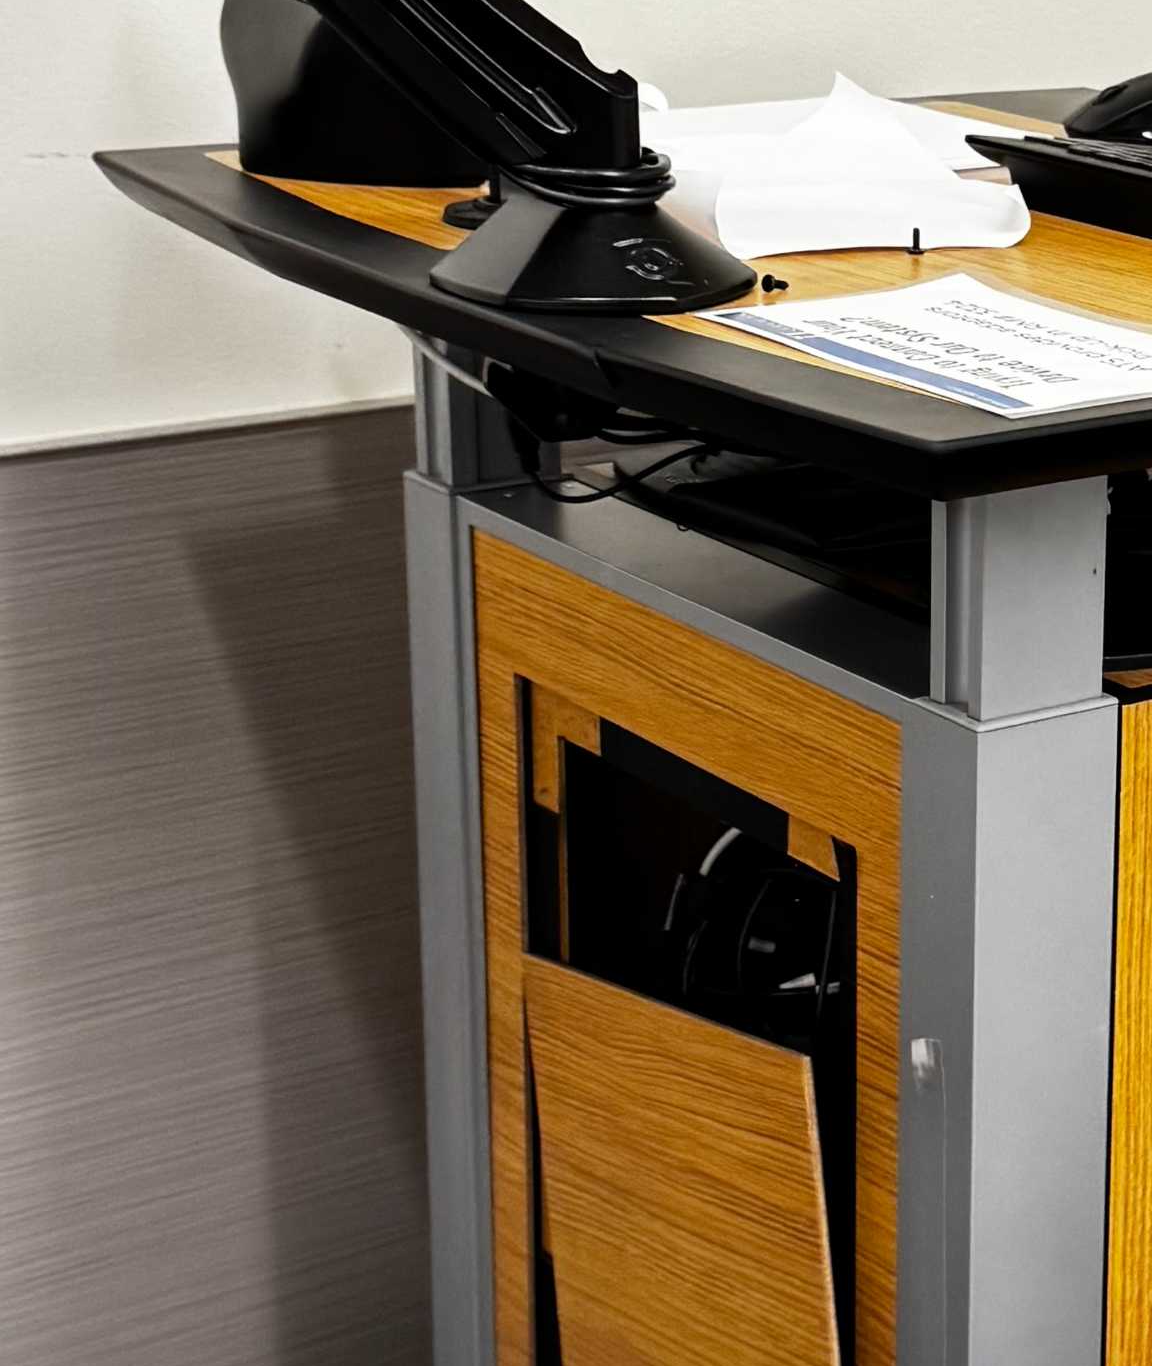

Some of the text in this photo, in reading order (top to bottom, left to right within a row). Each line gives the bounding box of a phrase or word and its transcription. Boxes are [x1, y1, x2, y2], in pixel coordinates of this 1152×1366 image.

[838, 316, 941, 343] System?
[844, 334, 942, 361] Connect
[928, 341, 981, 355] Our
[958, 367, 1034, 389] Trying
[996, 360, 1080, 384] Device
